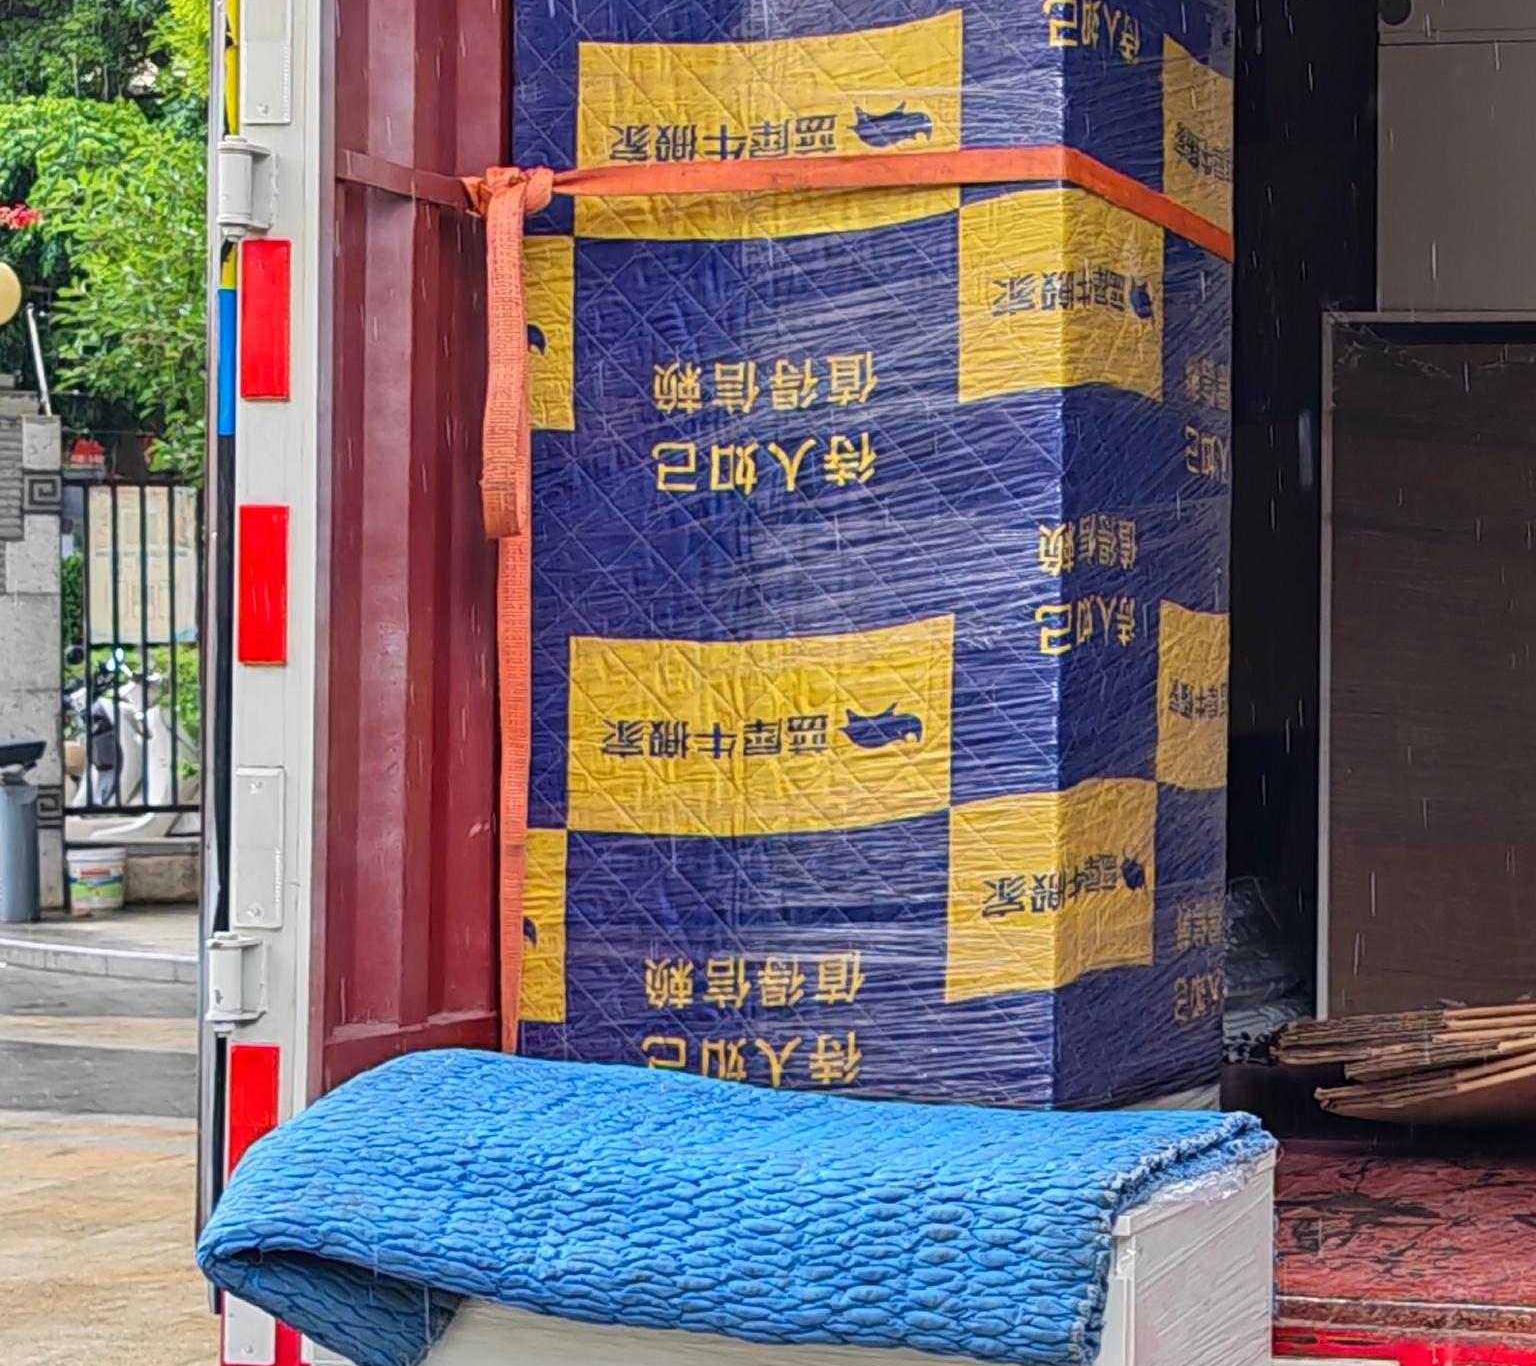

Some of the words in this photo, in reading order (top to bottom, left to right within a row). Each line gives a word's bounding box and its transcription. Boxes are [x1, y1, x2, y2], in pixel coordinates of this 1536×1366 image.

[609, 114, 838, 162] 蓝犀牛搬家
[653, 351, 878, 414] 值得信赖
[652, 432, 877, 495] 待人如己
[1039, 514, 1137, 576] 值得信赖
[1035, 595, 1135, 655] 待人如己
[602, 715, 829, 759] 蓝犀牛搬家
[644, 950, 865, 1009] 值得信赖
